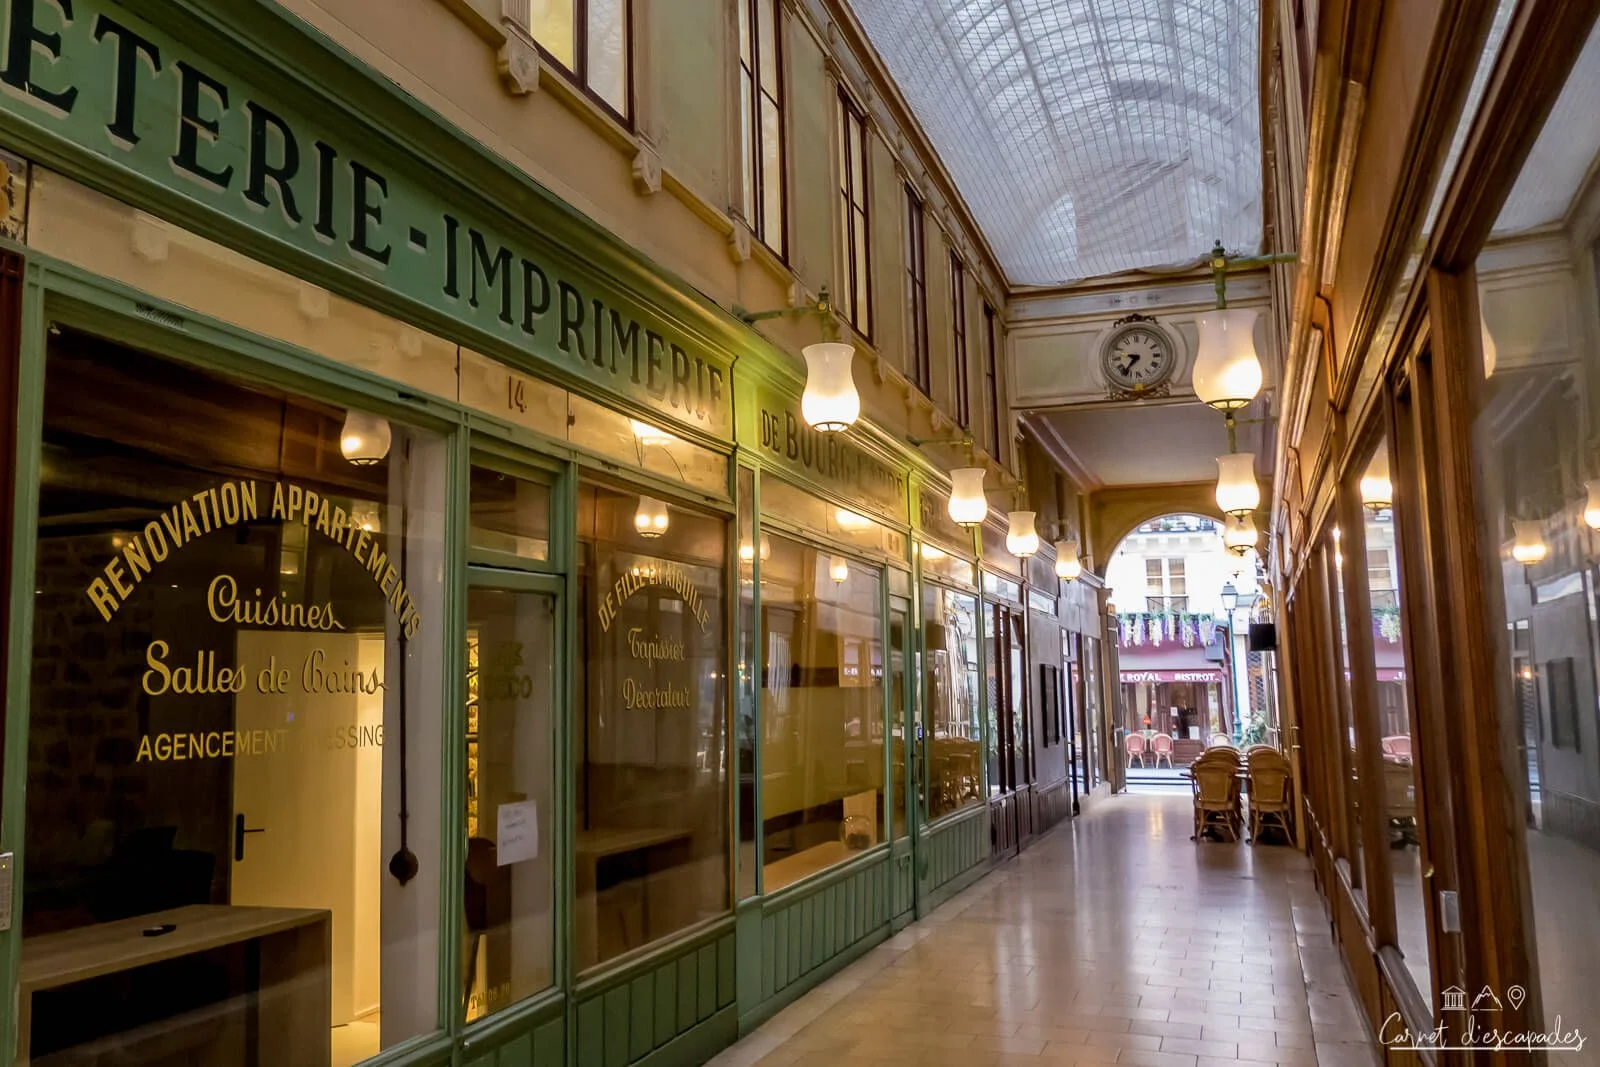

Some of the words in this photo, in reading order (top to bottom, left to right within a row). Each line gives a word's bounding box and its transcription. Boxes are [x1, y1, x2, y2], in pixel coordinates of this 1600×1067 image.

[508, 375, 527, 413] 14
[761, 409, 781, 453] DE
[86, 480, 258, 623] RENOVATION
[271, 481, 423, 642] APPARTEMENTS
[207, 574, 346, 631] Cuisines
[599, 591, 617, 633] DE
[665, 563, 710, 633] AIGUILLE
[142, 639, 247, 696] Salles
[256, 655, 292, 695] de
[301, 648, 391, 695] Bains
[627, 627, 686, 669] Tapissier
[623, 677, 691, 710] Décorateur
[1127, 671, 1161, 682] ROYAL
[1174, 672, 1216, 682] BISTROT
[136, 729, 289, 762] AGENCEMENT
